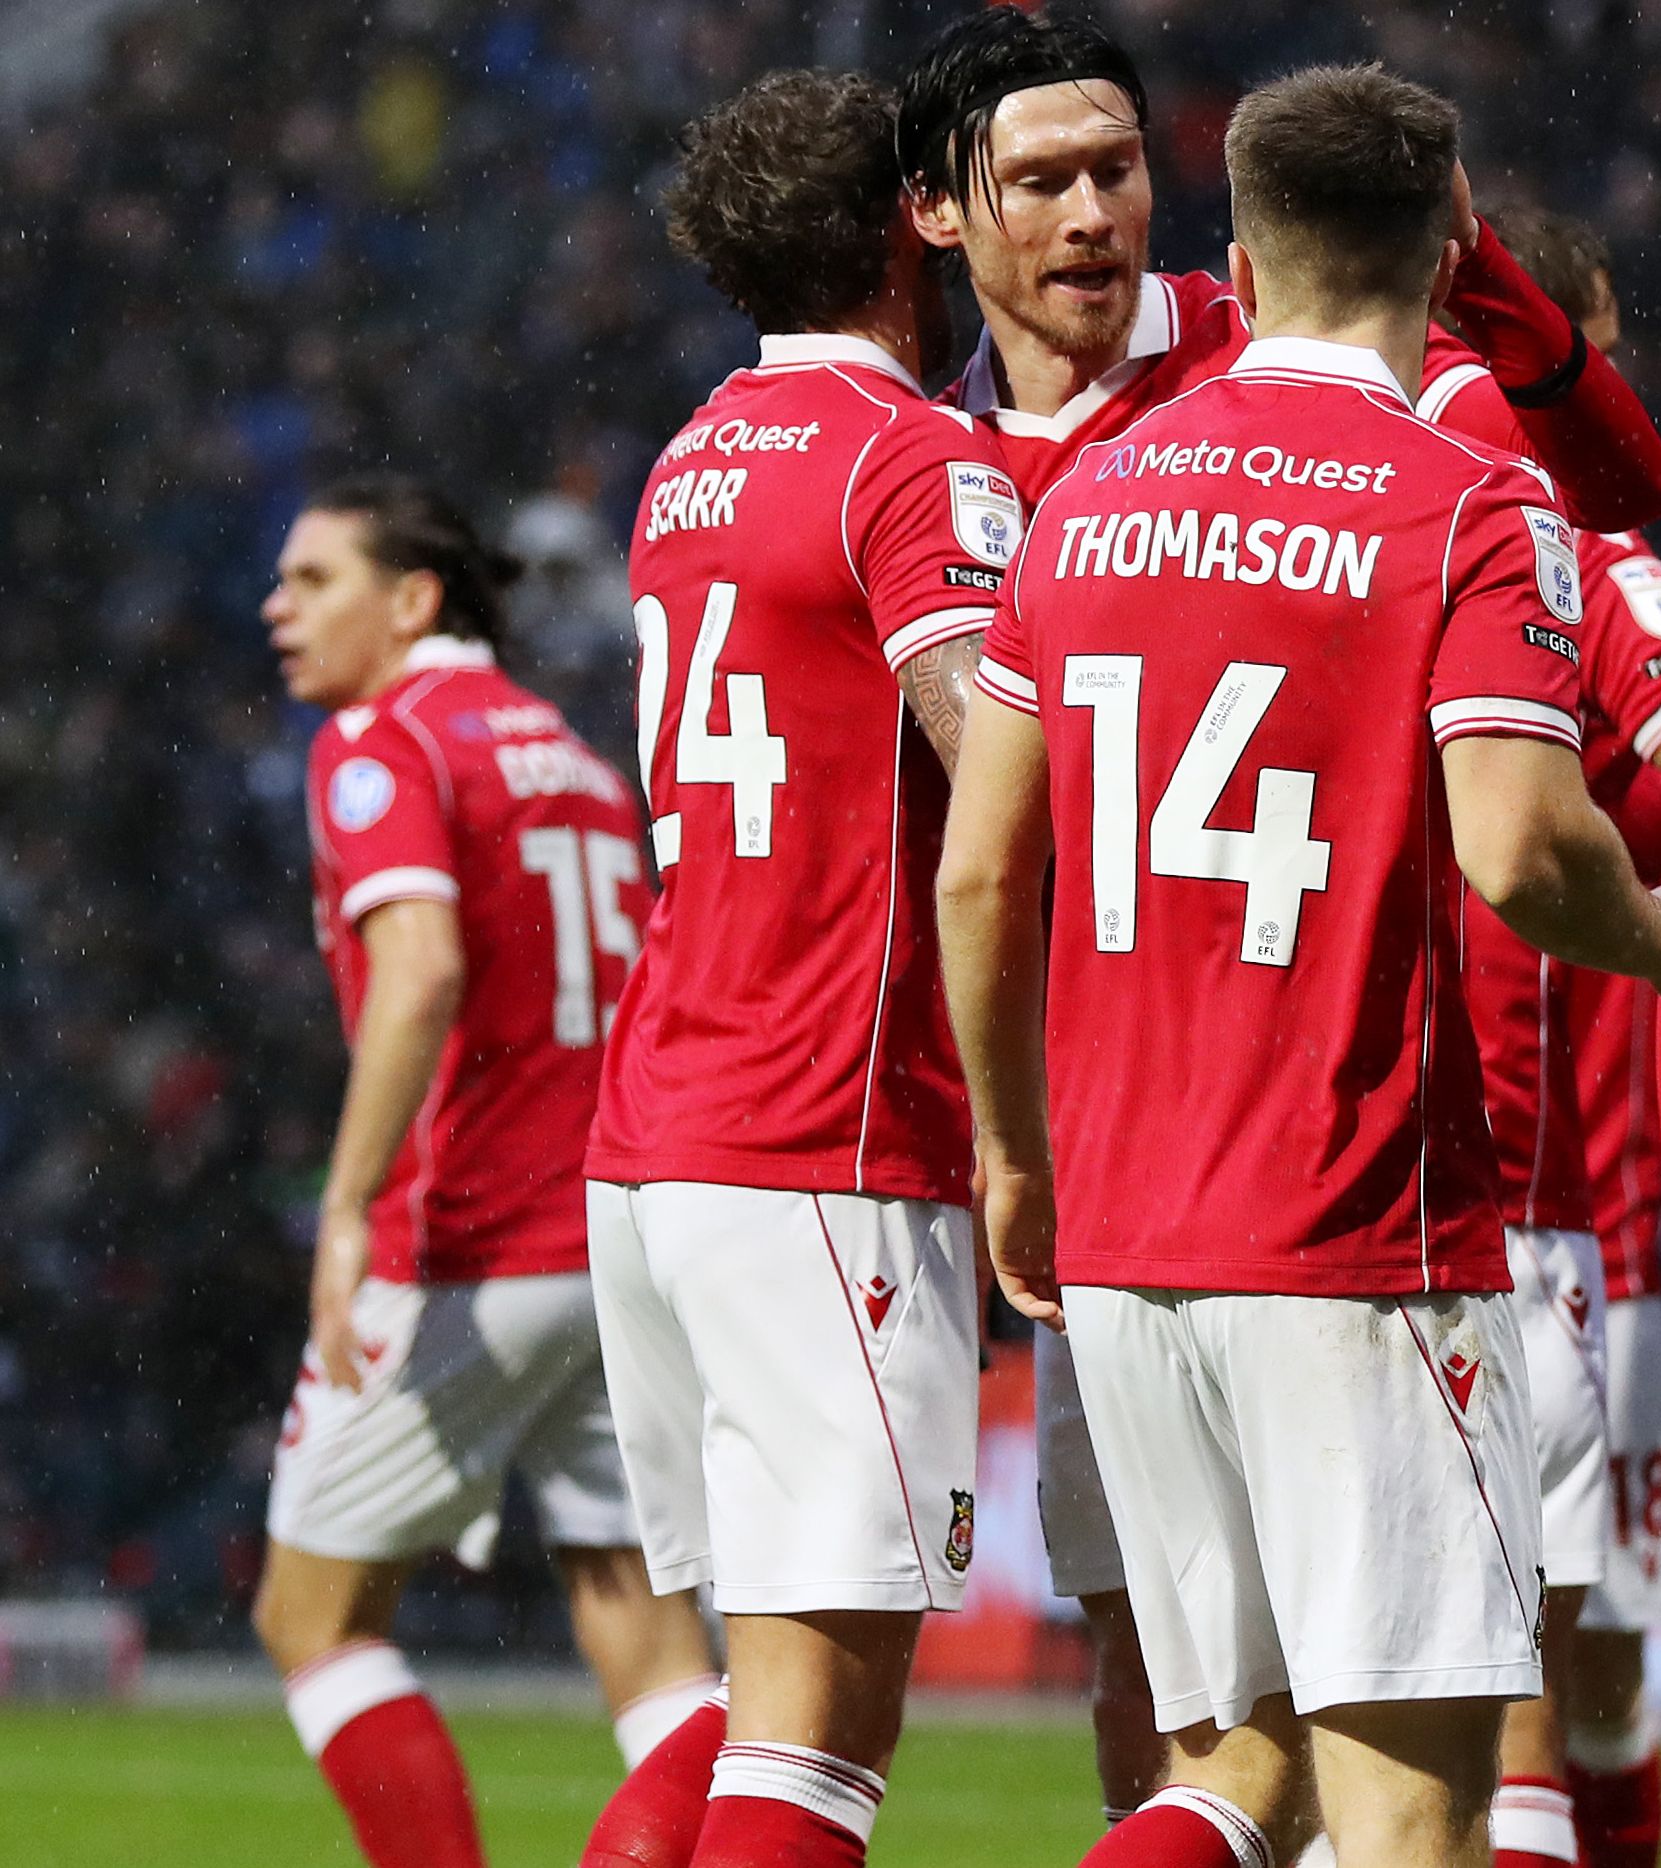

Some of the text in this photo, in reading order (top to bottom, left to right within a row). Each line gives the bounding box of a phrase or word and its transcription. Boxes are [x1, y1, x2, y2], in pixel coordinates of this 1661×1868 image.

[714, 418, 820, 456] Quest
[958, 473, 985, 490] sky
[1135, 440, 1397, 494] Meta Quest
[645, 467, 749, 542] SCARR
[985, 542, 1008, 558] EFL
[1054, 509, 1384, 600] THOMASON
[1556, 593, 1573, 613] EFL
[1062, 653, 1332, 967] 14
[1105, 934, 1118, 944] EFL
[1258, 946, 1275, 957] EFL
